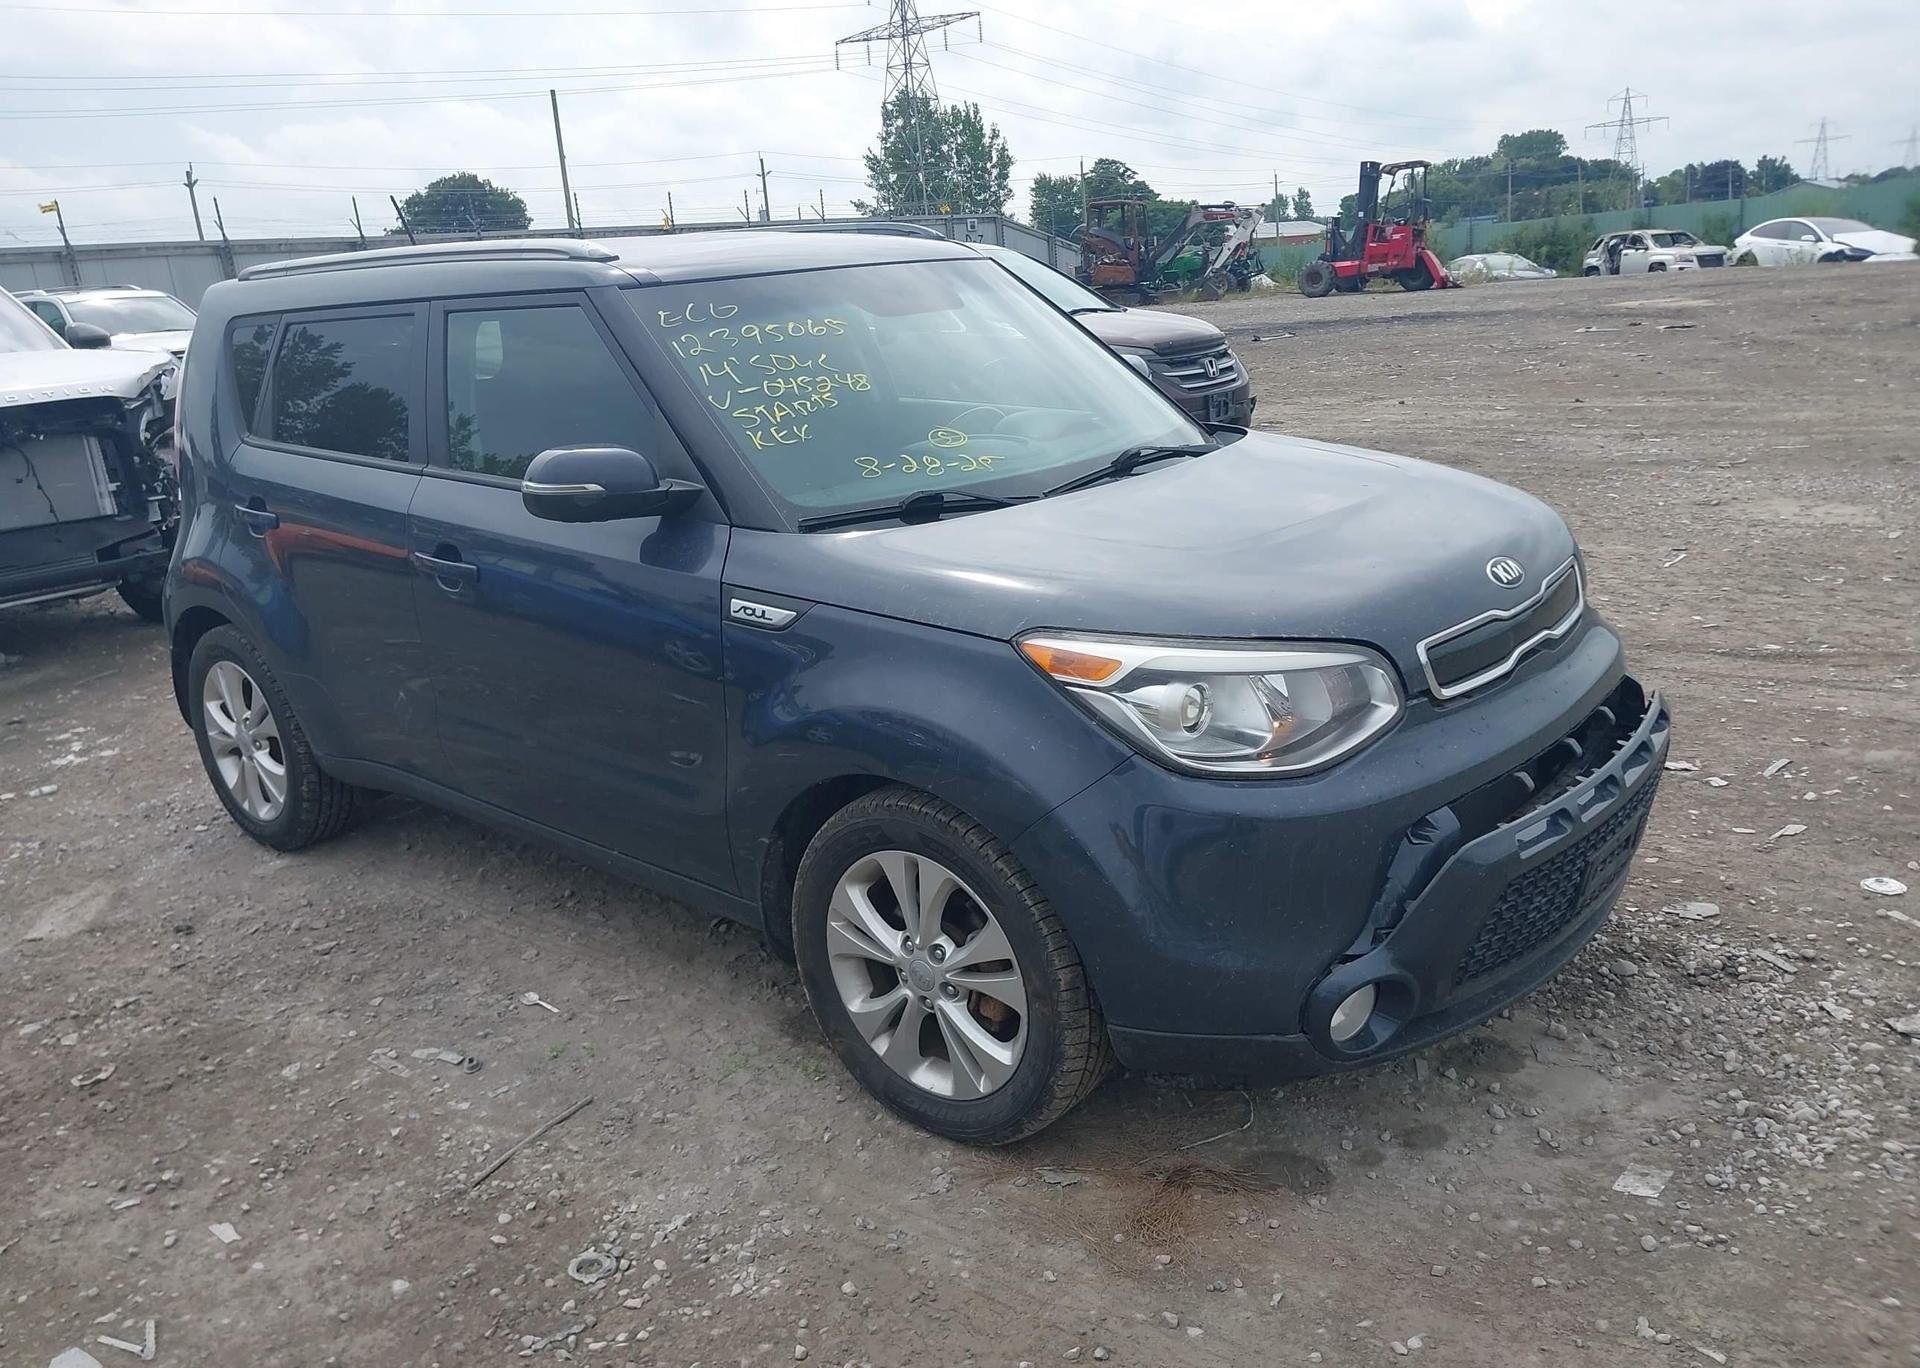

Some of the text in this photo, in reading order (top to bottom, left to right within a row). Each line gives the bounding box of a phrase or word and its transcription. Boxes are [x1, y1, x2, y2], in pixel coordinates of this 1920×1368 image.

[672, 318, 848, 358] 12395065
[732, 392, 839, 429] STARTS
[745, 424, 812, 450] KEY
[854, 454, 1005, 478] 8-28-25
[1491, 560, 1523, 583] KIA
